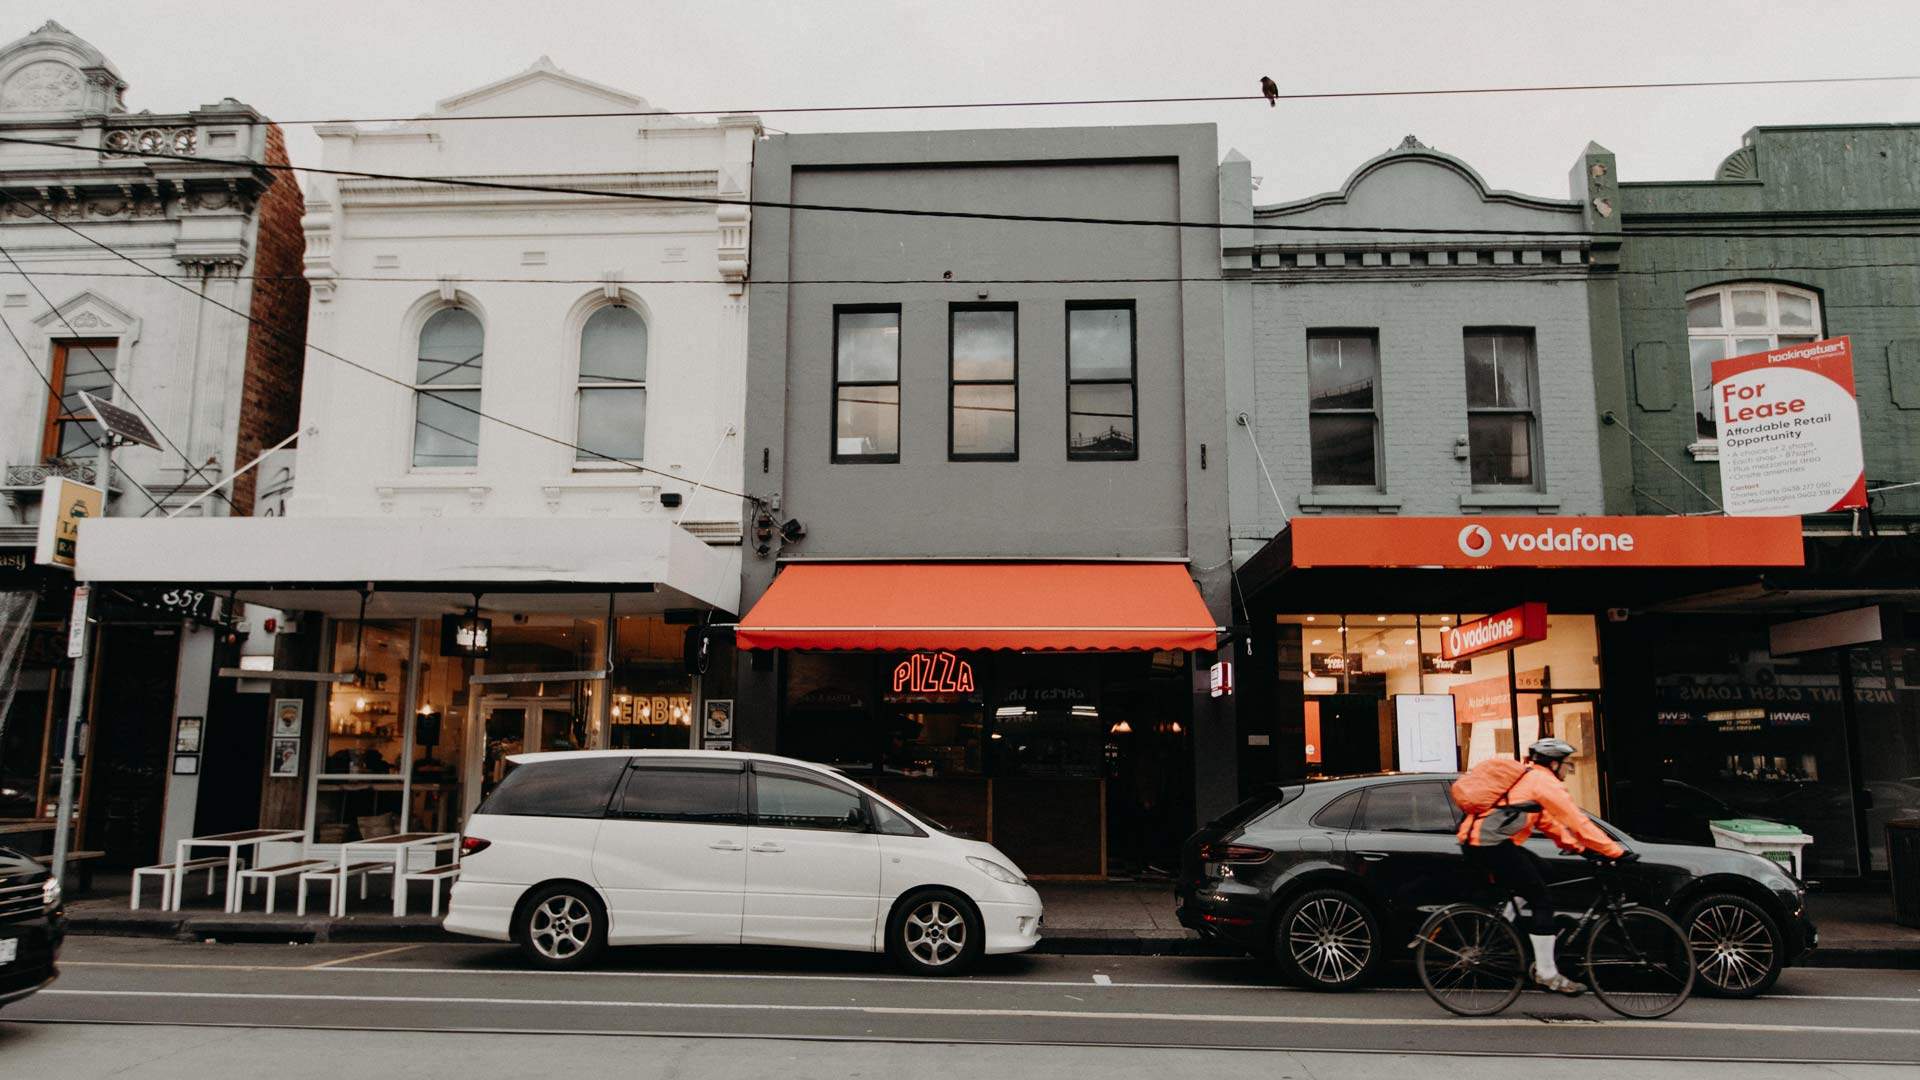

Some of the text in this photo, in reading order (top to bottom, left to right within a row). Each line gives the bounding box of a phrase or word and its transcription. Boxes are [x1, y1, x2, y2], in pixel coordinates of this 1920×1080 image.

[1768, 341, 1845, 363] hockingstuart
[1723, 384, 1765, 402] For
[1724, 399, 1805, 423] Lease
[1726, 414, 1831, 437] Affordable Retail
[1727, 431, 1802, 448] Opportunity
[1730, 483, 1759, 492] Contact
[1501, 528, 1634, 551] vodafone
[1463, 617, 1513, 649] vodafone
[894, 651, 974, 692] PIZZA
